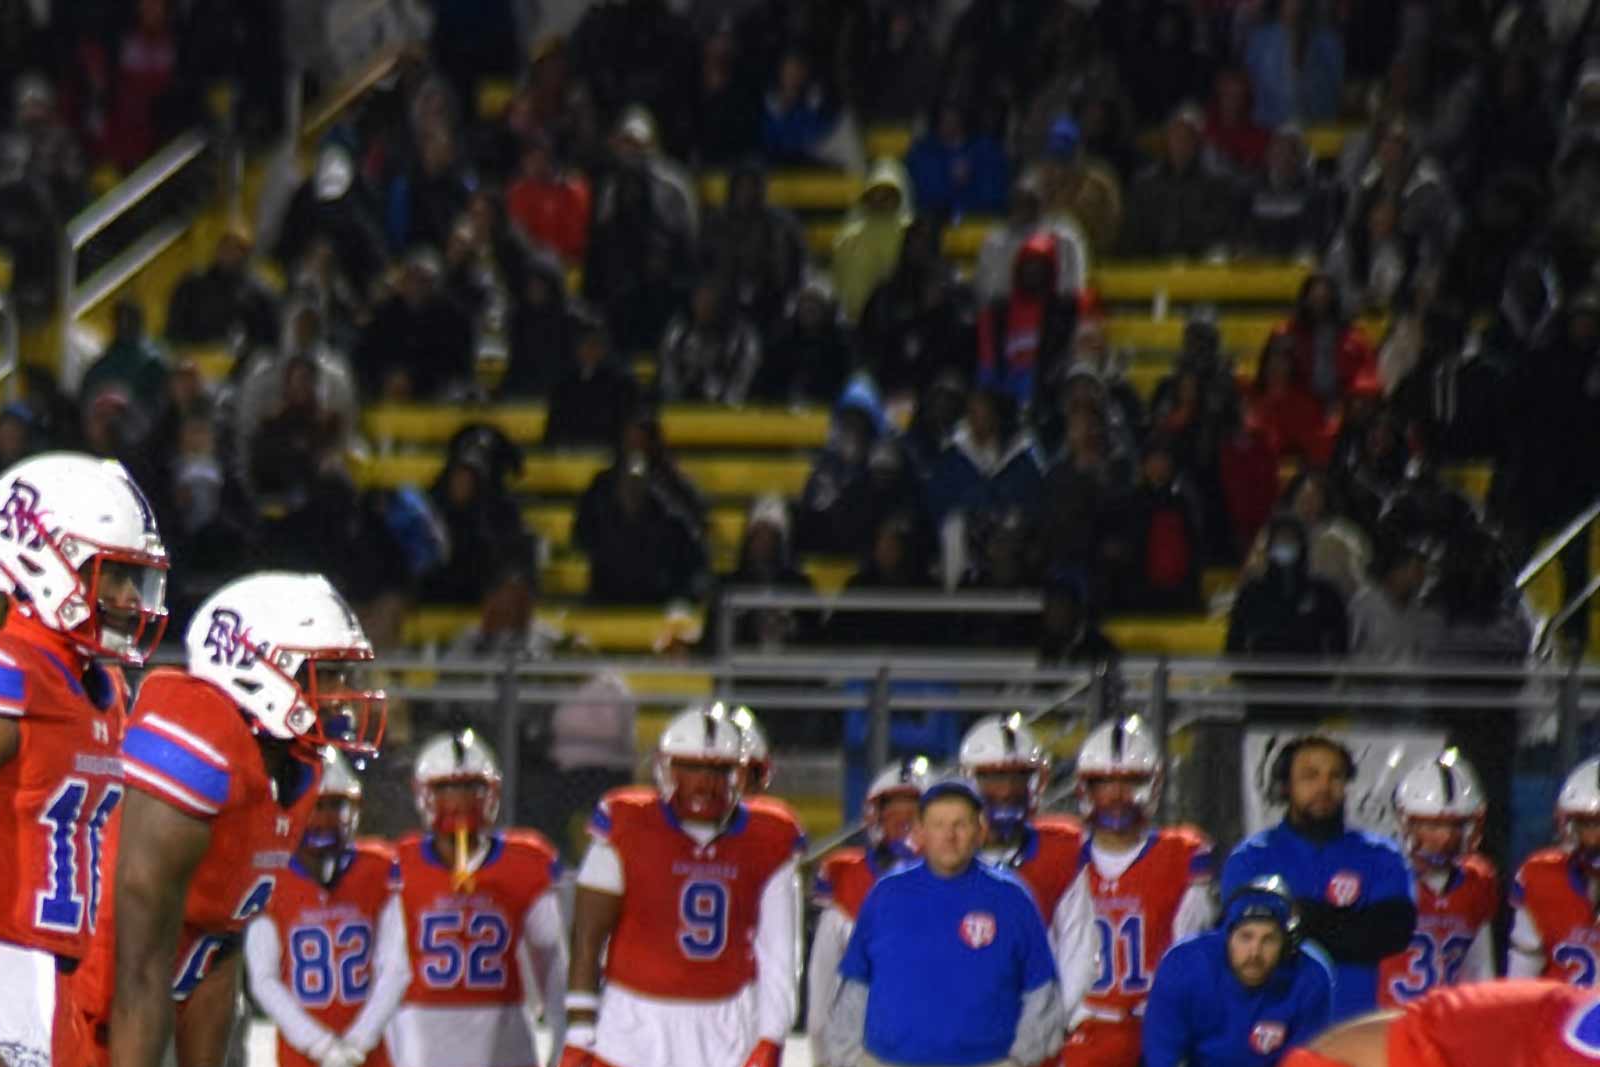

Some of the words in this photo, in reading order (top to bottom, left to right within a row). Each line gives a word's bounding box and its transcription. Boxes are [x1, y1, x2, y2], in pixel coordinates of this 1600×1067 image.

[420, 909, 511, 990] 52
[677, 877, 730, 961] 9
[289, 919, 372, 1008] 82
